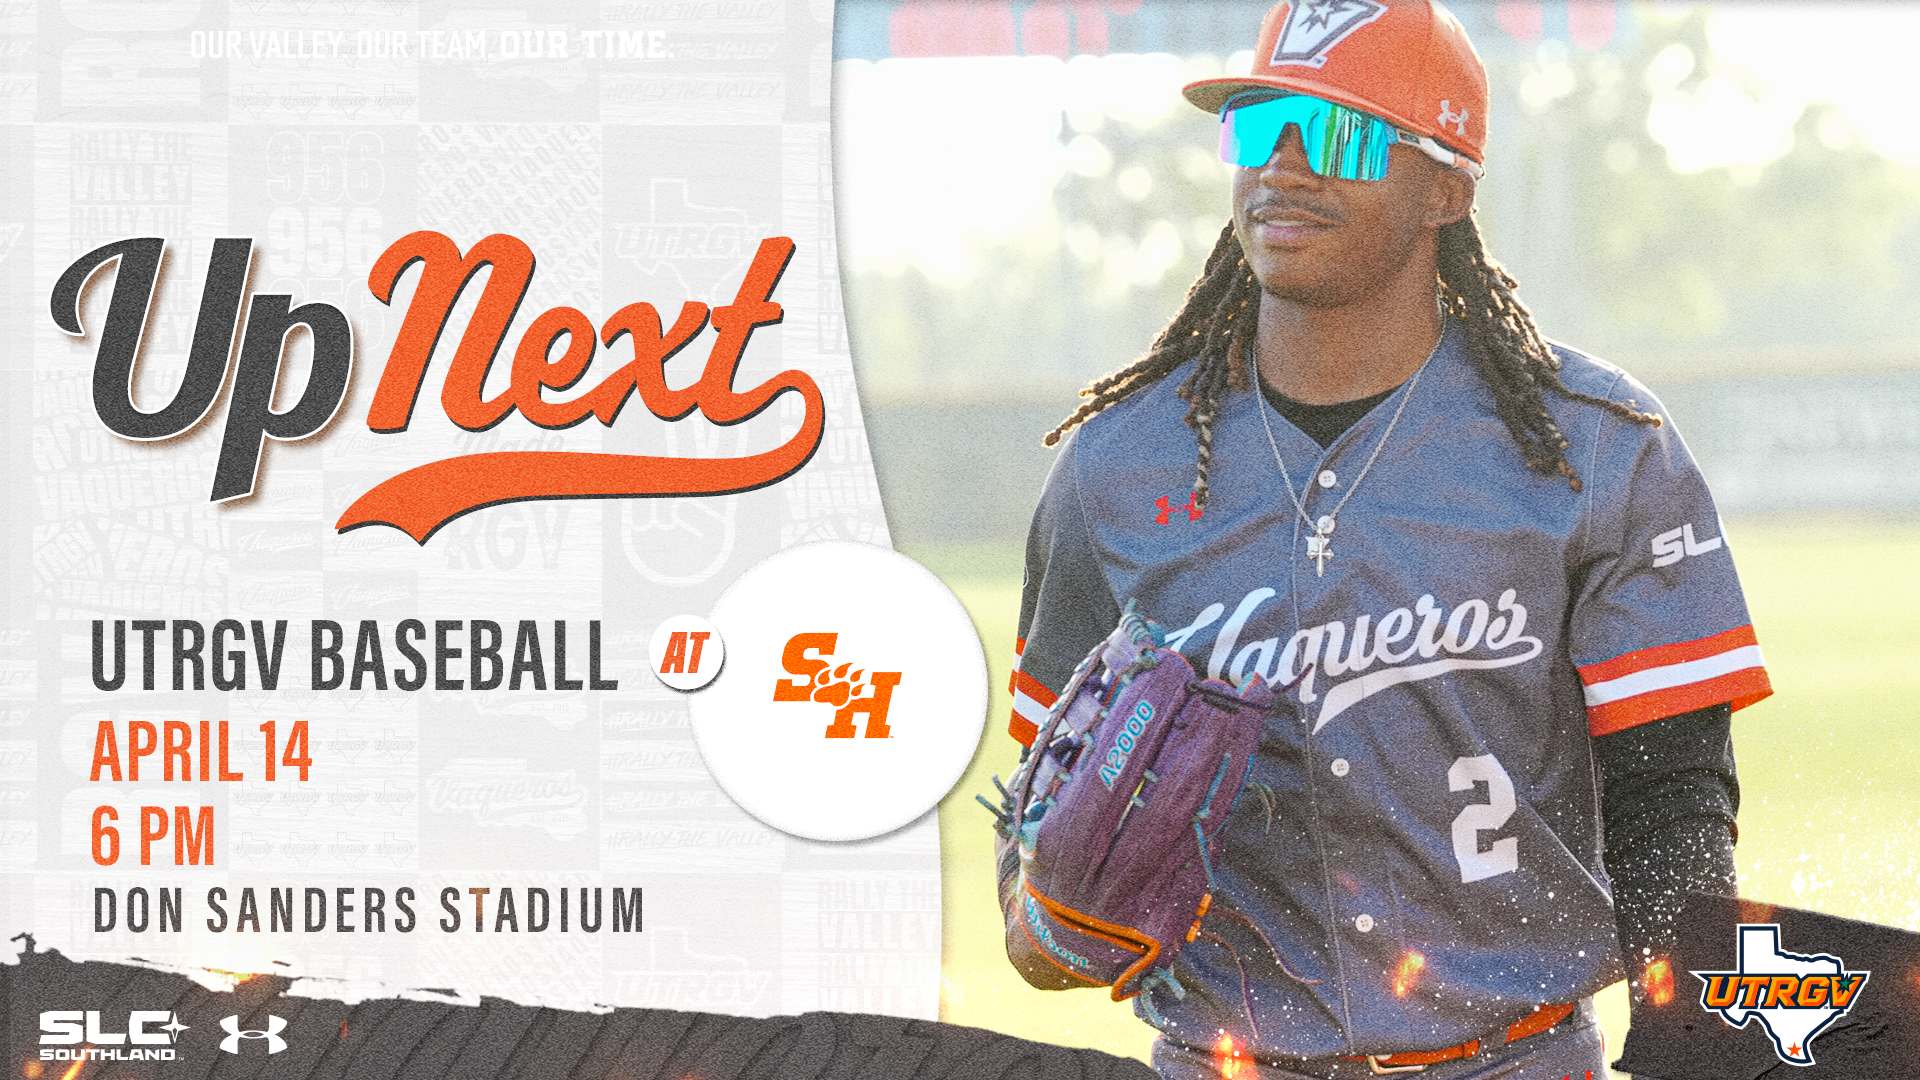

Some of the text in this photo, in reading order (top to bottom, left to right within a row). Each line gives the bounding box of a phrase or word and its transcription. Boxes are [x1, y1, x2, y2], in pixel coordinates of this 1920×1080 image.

[1166, 587, 1543, 735] Vaqueros
[1099, 700, 1154, 792] A2000
[1447, 753, 1519, 884] 2
